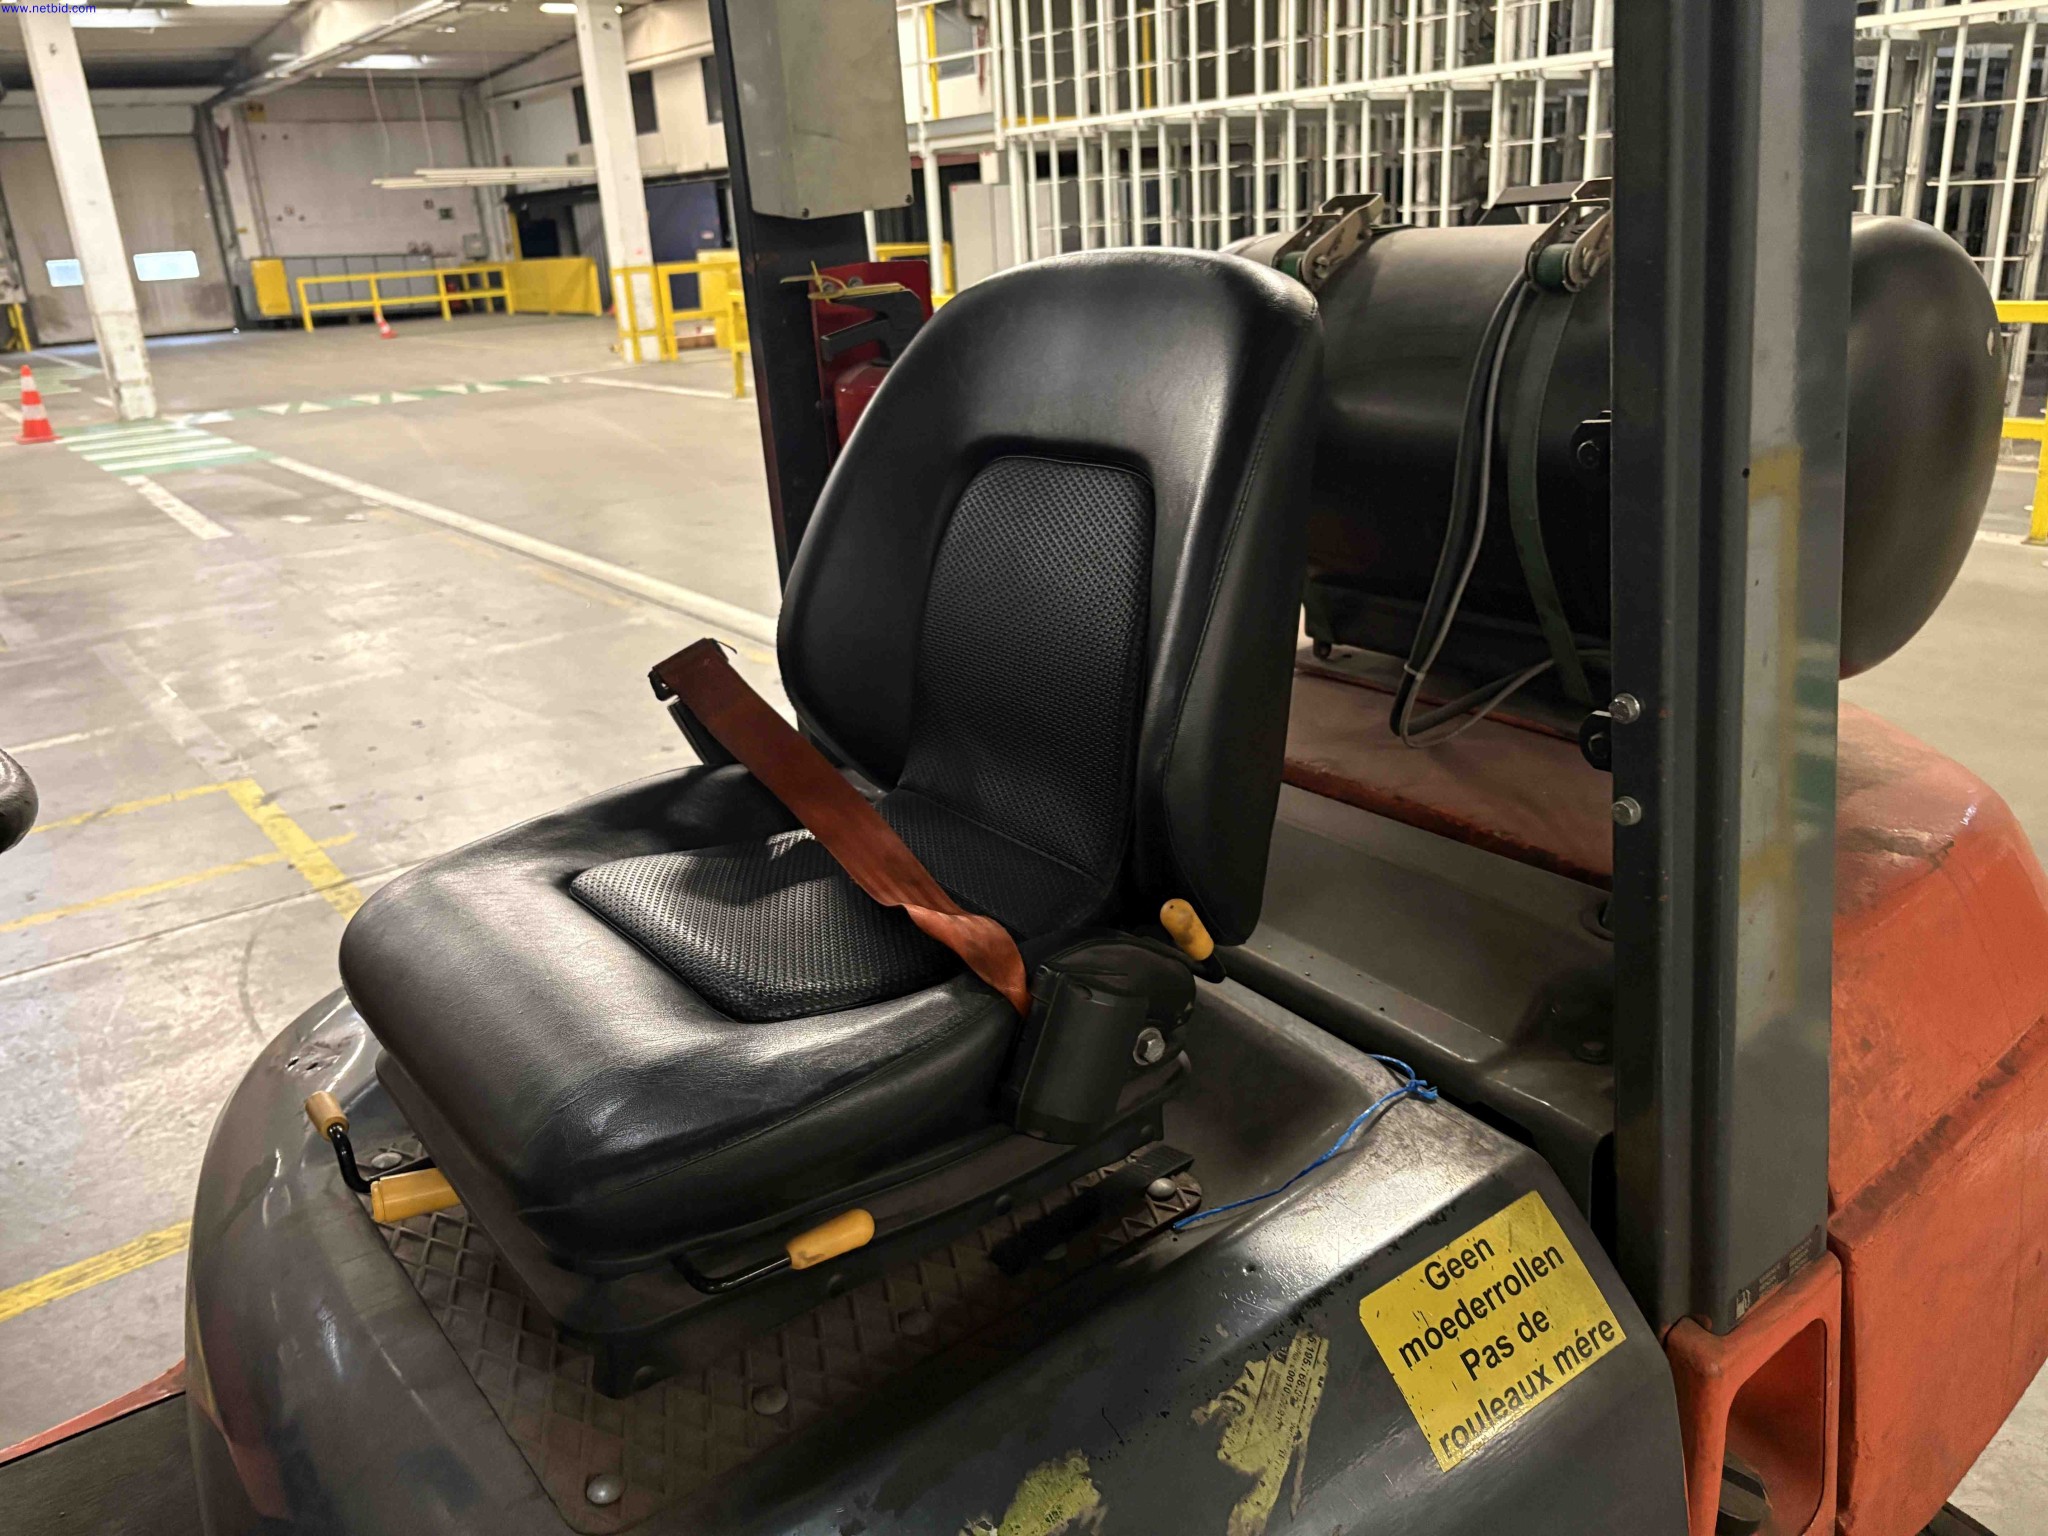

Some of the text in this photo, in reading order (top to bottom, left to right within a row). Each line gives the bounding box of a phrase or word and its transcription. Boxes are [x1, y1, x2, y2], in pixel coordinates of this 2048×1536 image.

[1424, 1238, 1495, 1290] Geen
[1398, 1245, 1565, 1368] moederrollen
[1459, 1309, 1550, 1381] Pas de
[1438, 1364, 1554, 1458] rouleaux
